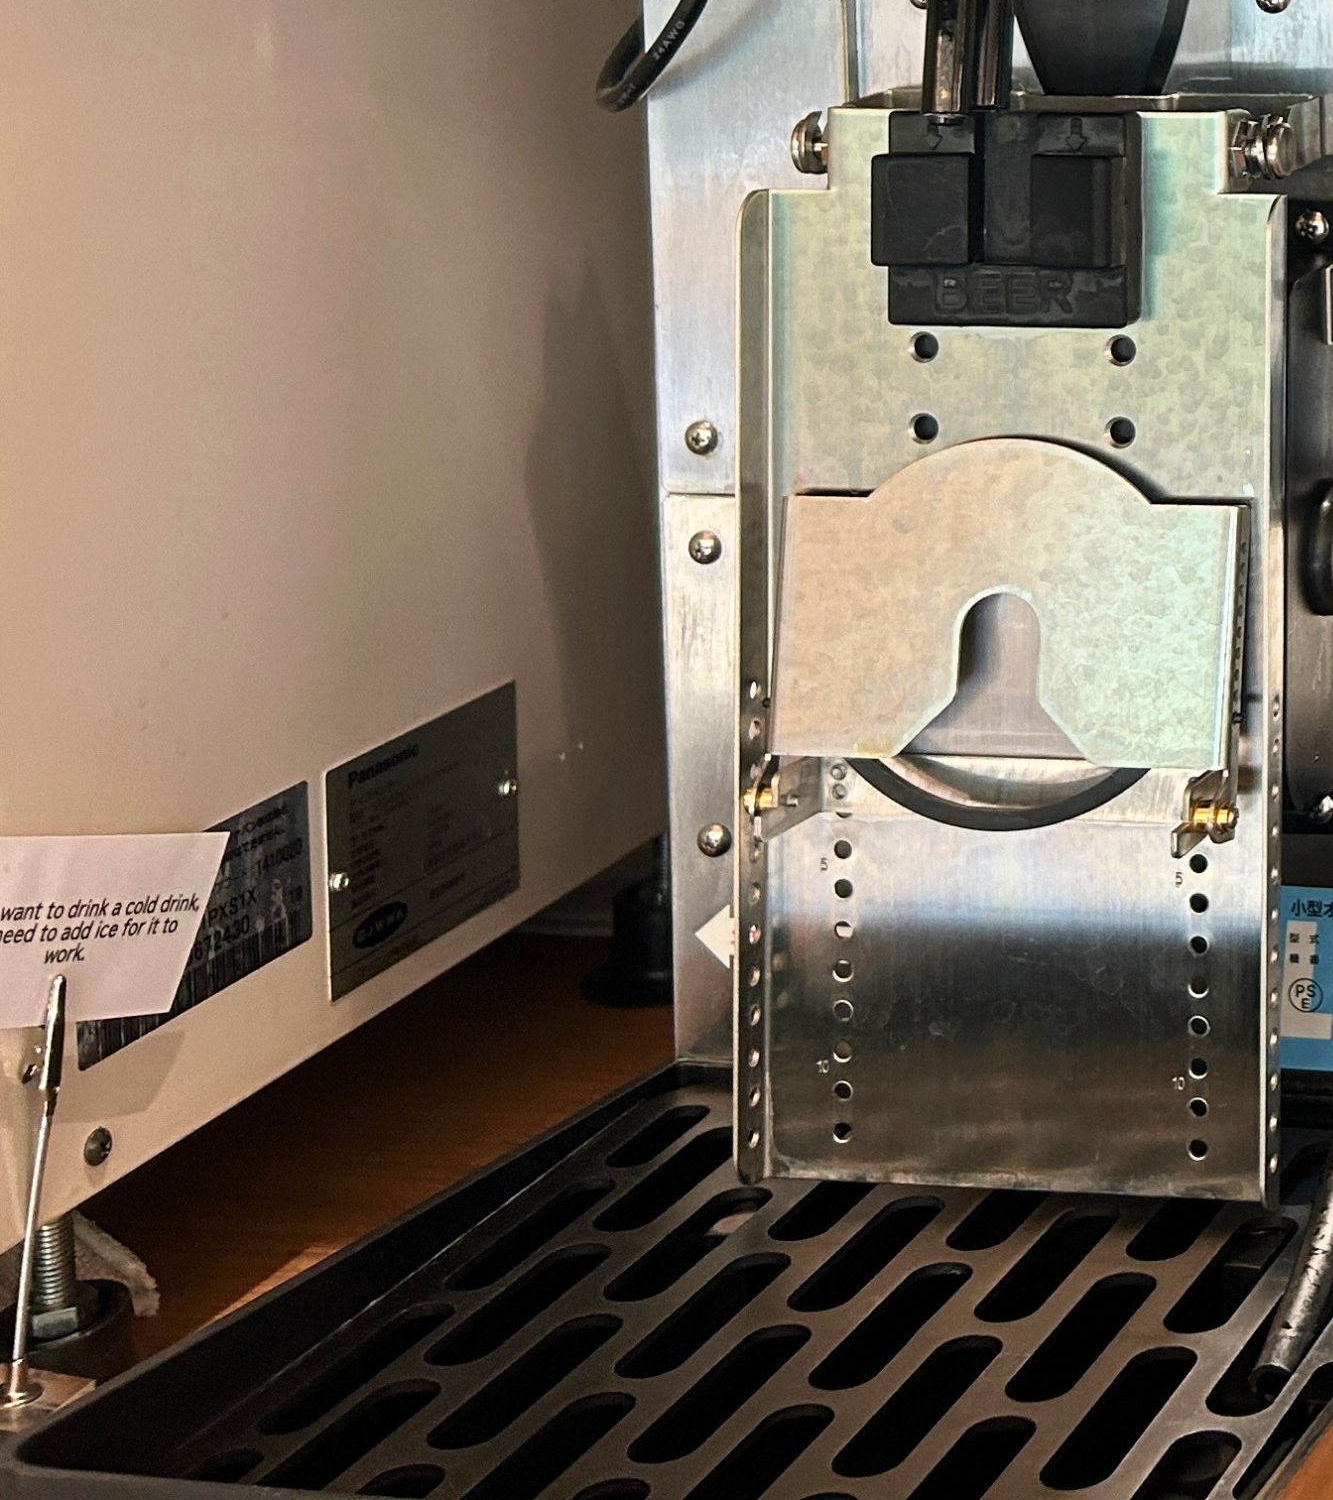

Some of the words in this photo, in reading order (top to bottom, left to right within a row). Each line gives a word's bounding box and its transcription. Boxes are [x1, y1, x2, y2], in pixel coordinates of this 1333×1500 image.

[934, 270, 1074, 317] BEER
[348, 743, 420, 789] Panasonic
[1, 902, 43, 922] want
[47, 902, 64, 920] to
[68, 897, 110, 919] drink
[111, 902, 122, 917] a
[125, 895, 159, 915] cold
[160, 893, 200, 913] drink,
[0, 924, 38, 944] eed
[40, 924, 57, 942] to
[60, 921, 94, 941] add
[94, 920, 119, 939] ice
[121, 918, 147, 937] for
[147, 917, 161, 935] it
[162, 919, 178, 934] to
[44, 943, 85, 965] work.
